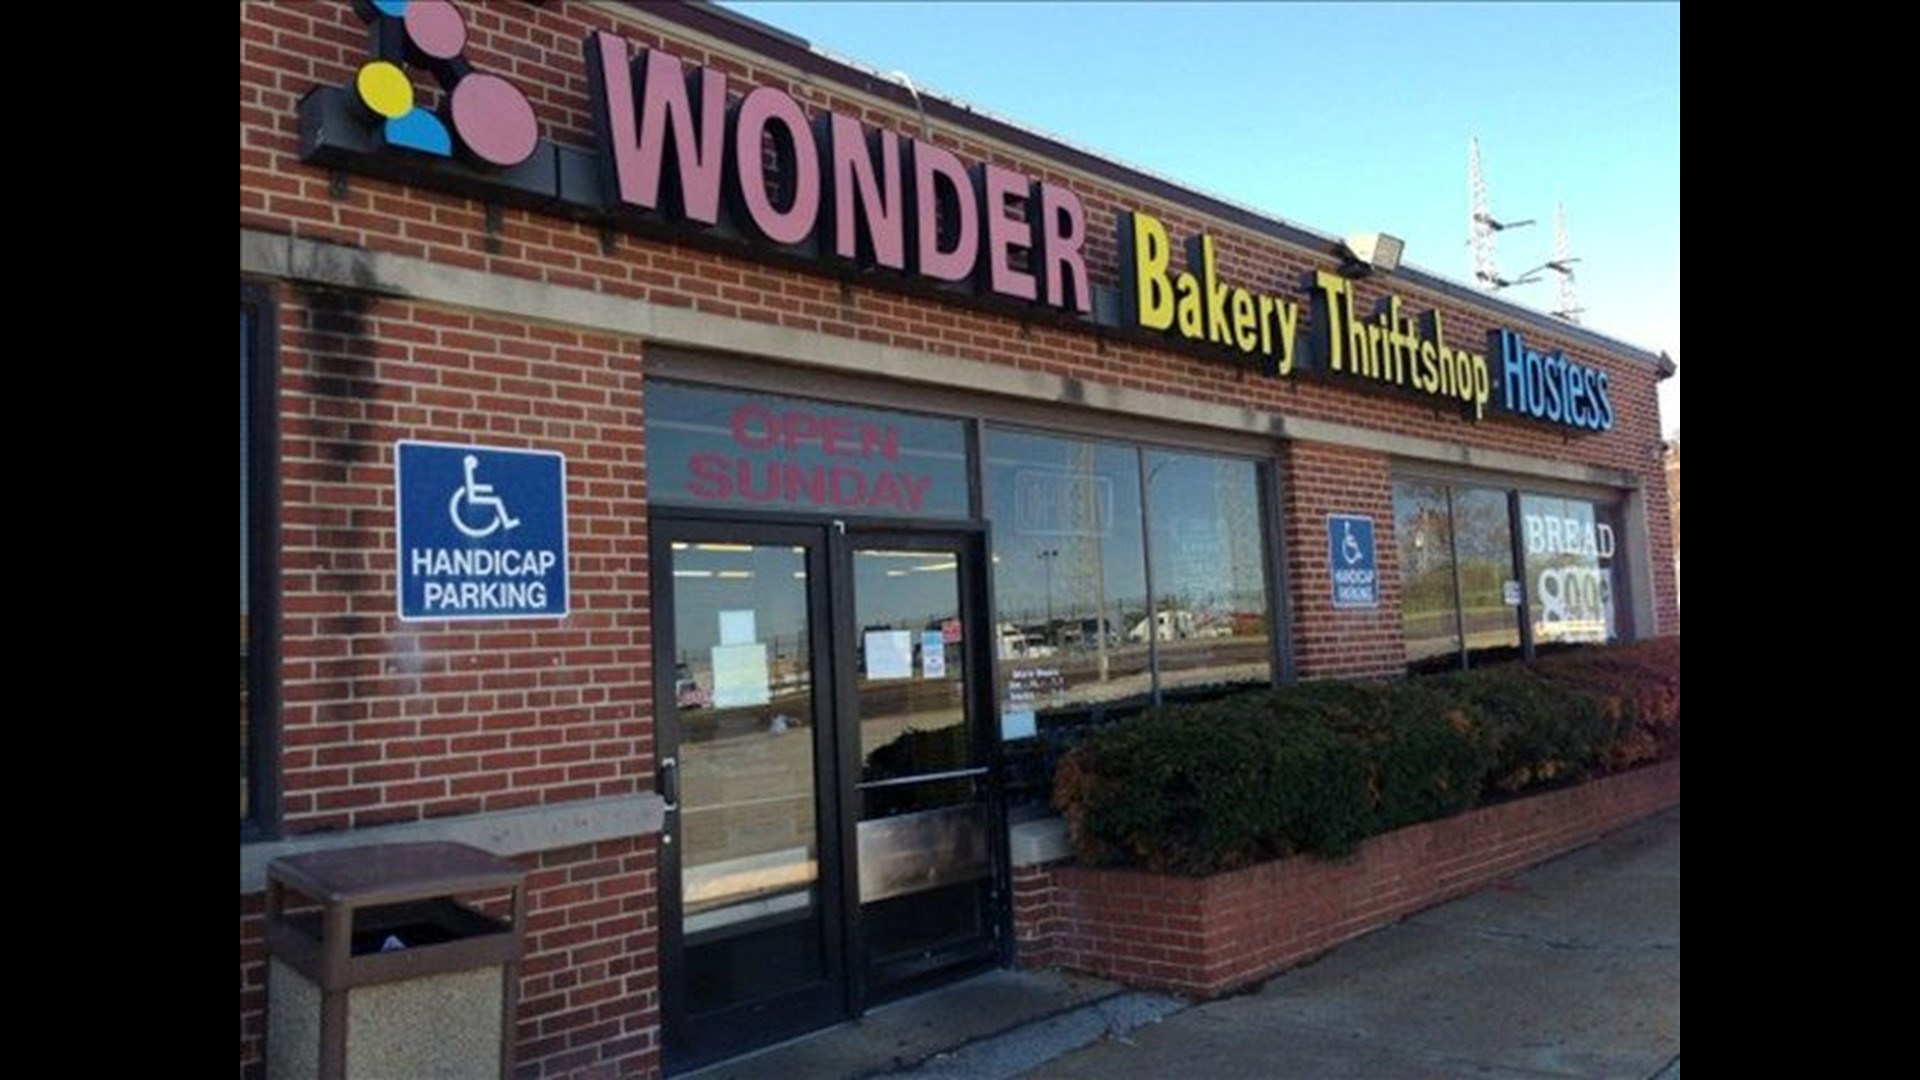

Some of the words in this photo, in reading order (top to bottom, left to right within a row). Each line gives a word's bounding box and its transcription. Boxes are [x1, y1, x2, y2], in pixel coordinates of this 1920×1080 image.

[598, 31, 1091, 313] WONDER
[1131, 211, 1299, 376] Bakery
[1314, 270, 1491, 419] Thriftshop
[1501, 329, 1614, 432] Hostess
[729, 402, 898, 462] OPEN
[686, 452, 933, 512] SUNDAY
[411, 548, 556, 576] HANDICAP
[1526, 515, 1615, 558] BREAD
[424, 581, 548, 609] PARKING
